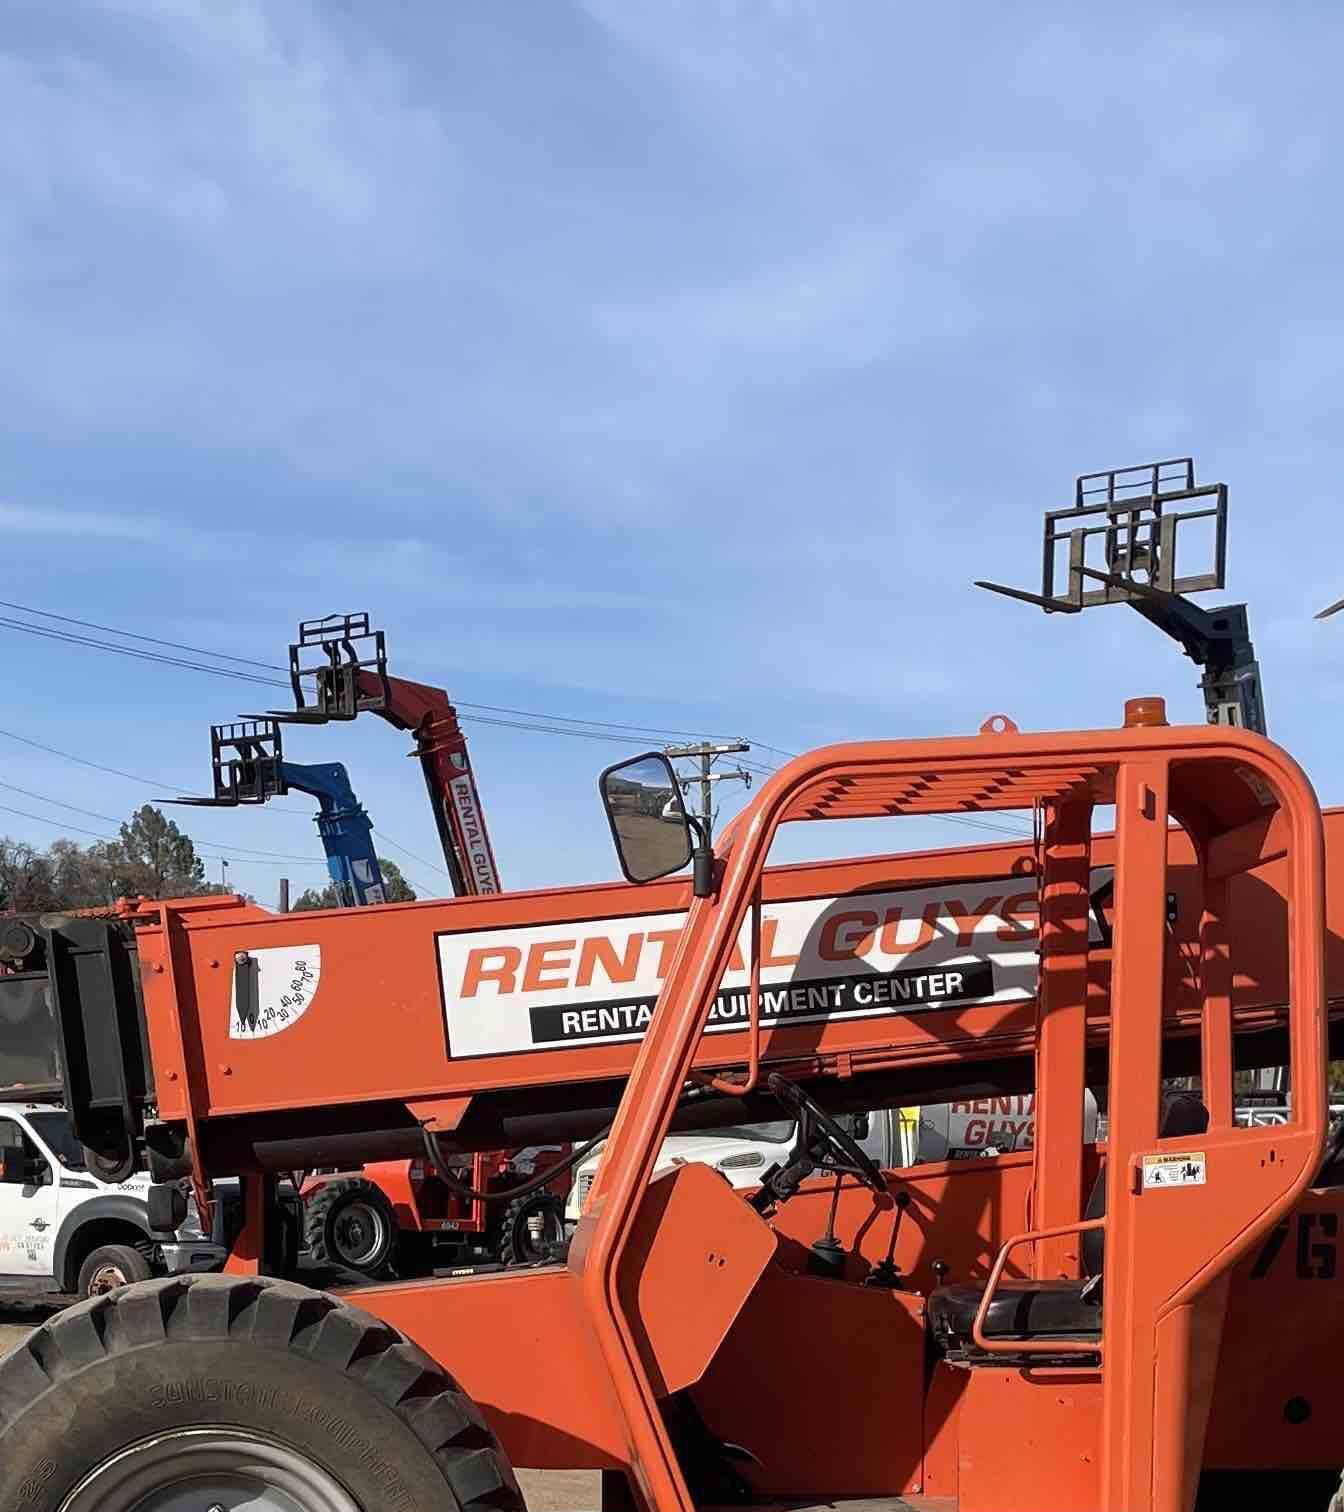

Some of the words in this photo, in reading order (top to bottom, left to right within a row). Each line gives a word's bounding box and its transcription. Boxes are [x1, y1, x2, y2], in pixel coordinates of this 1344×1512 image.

[456, 783, 482, 850] RENTAL
[818, 892, 1040, 961] GUYS
[301, 971, 313, 983] 70
[290, 979, 303, 992] 60
[281, 995, 292, 1008] 40
[292, 993, 305, 1005] 50
[562, 1005, 653, 1034] RENTA
[853, 972, 965, 1005] CENTER
[264, 1007, 276, 1020] 20
[277, 1008, 289, 1021] 30
[258, 1018, 268, 1030] 10
